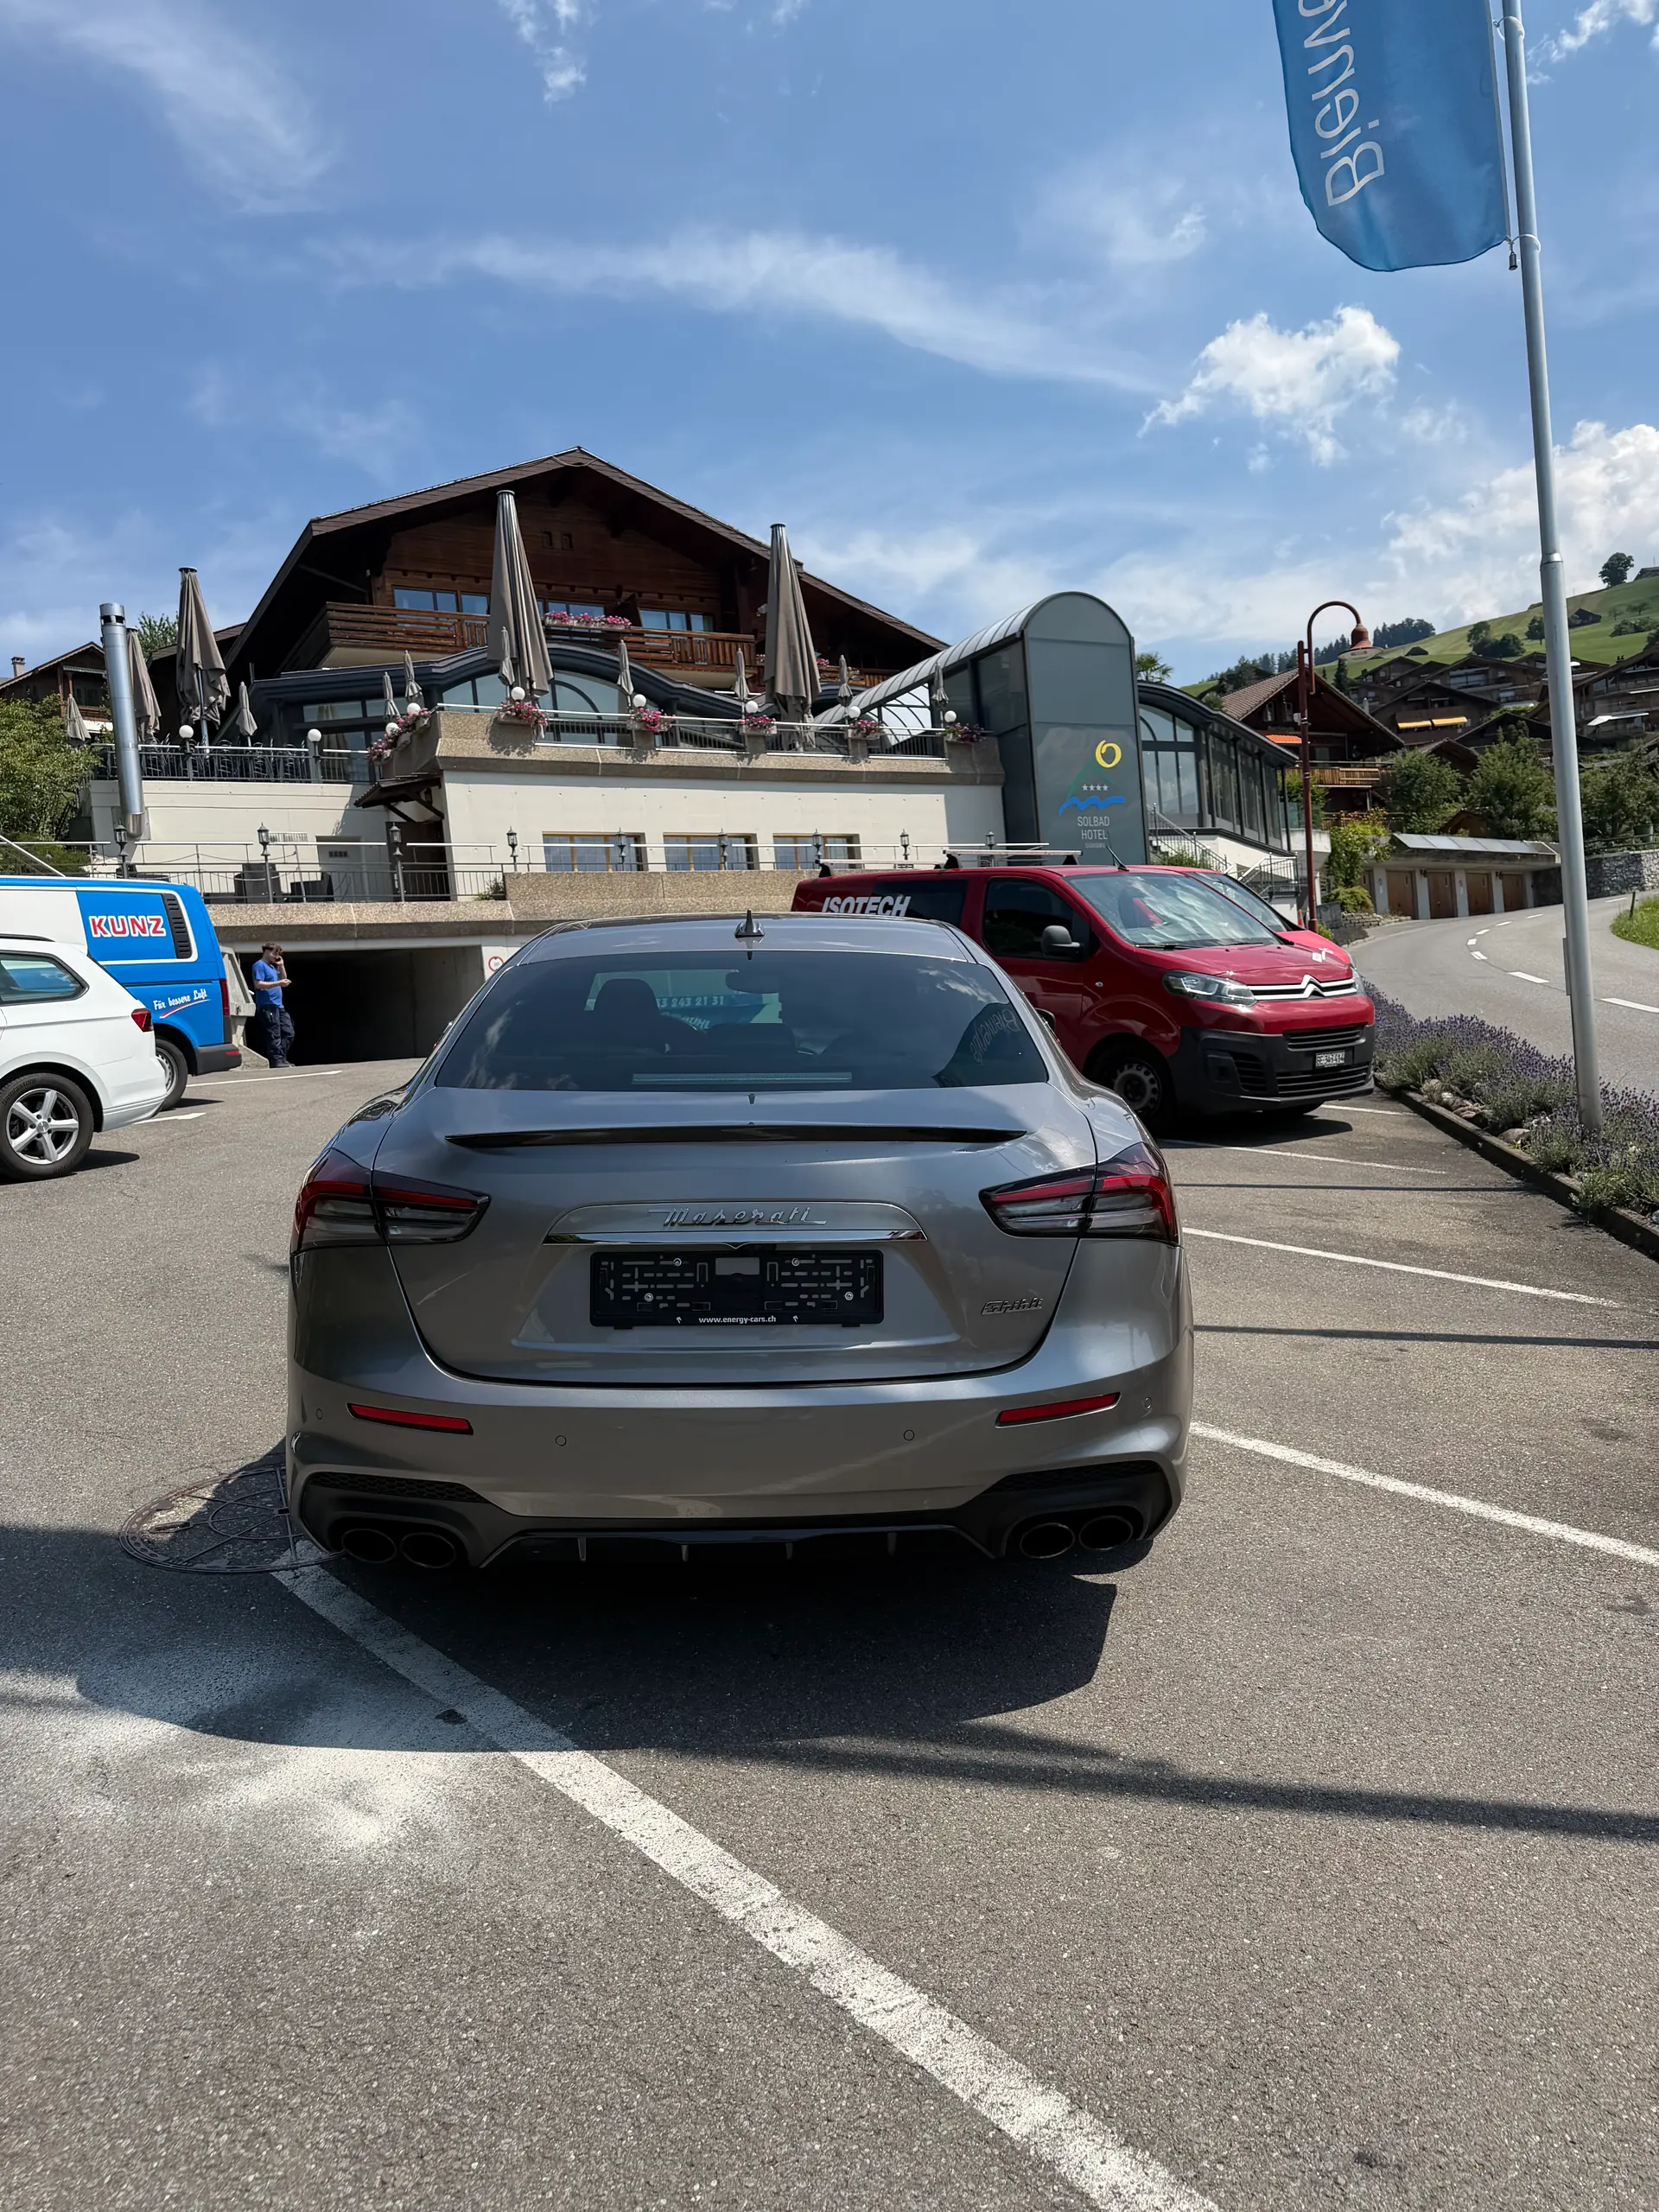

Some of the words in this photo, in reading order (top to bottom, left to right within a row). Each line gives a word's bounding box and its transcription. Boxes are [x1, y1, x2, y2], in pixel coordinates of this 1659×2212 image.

[1077, 816, 1110, 827] SOLBAD
[1081, 830, 1109, 840] HOTEL
[821, 895, 912, 918] ISOTECH
[89, 916, 166, 938] KUNZ
[153, 999, 167, 1010] Für
[168, 995, 191, 1007] bessere
[193, 988, 208, 1001] Luft
[671, 997, 691, 1007] 243
[696, 996, 708, 1006] 21
[712, 995, 724, 1006] 31
[648, 1206, 827, 1227] Maserati
[981, 1297, 1044, 1315] Ghibli
[698, 1315, 777, 1325] www.energy-cars.ch
